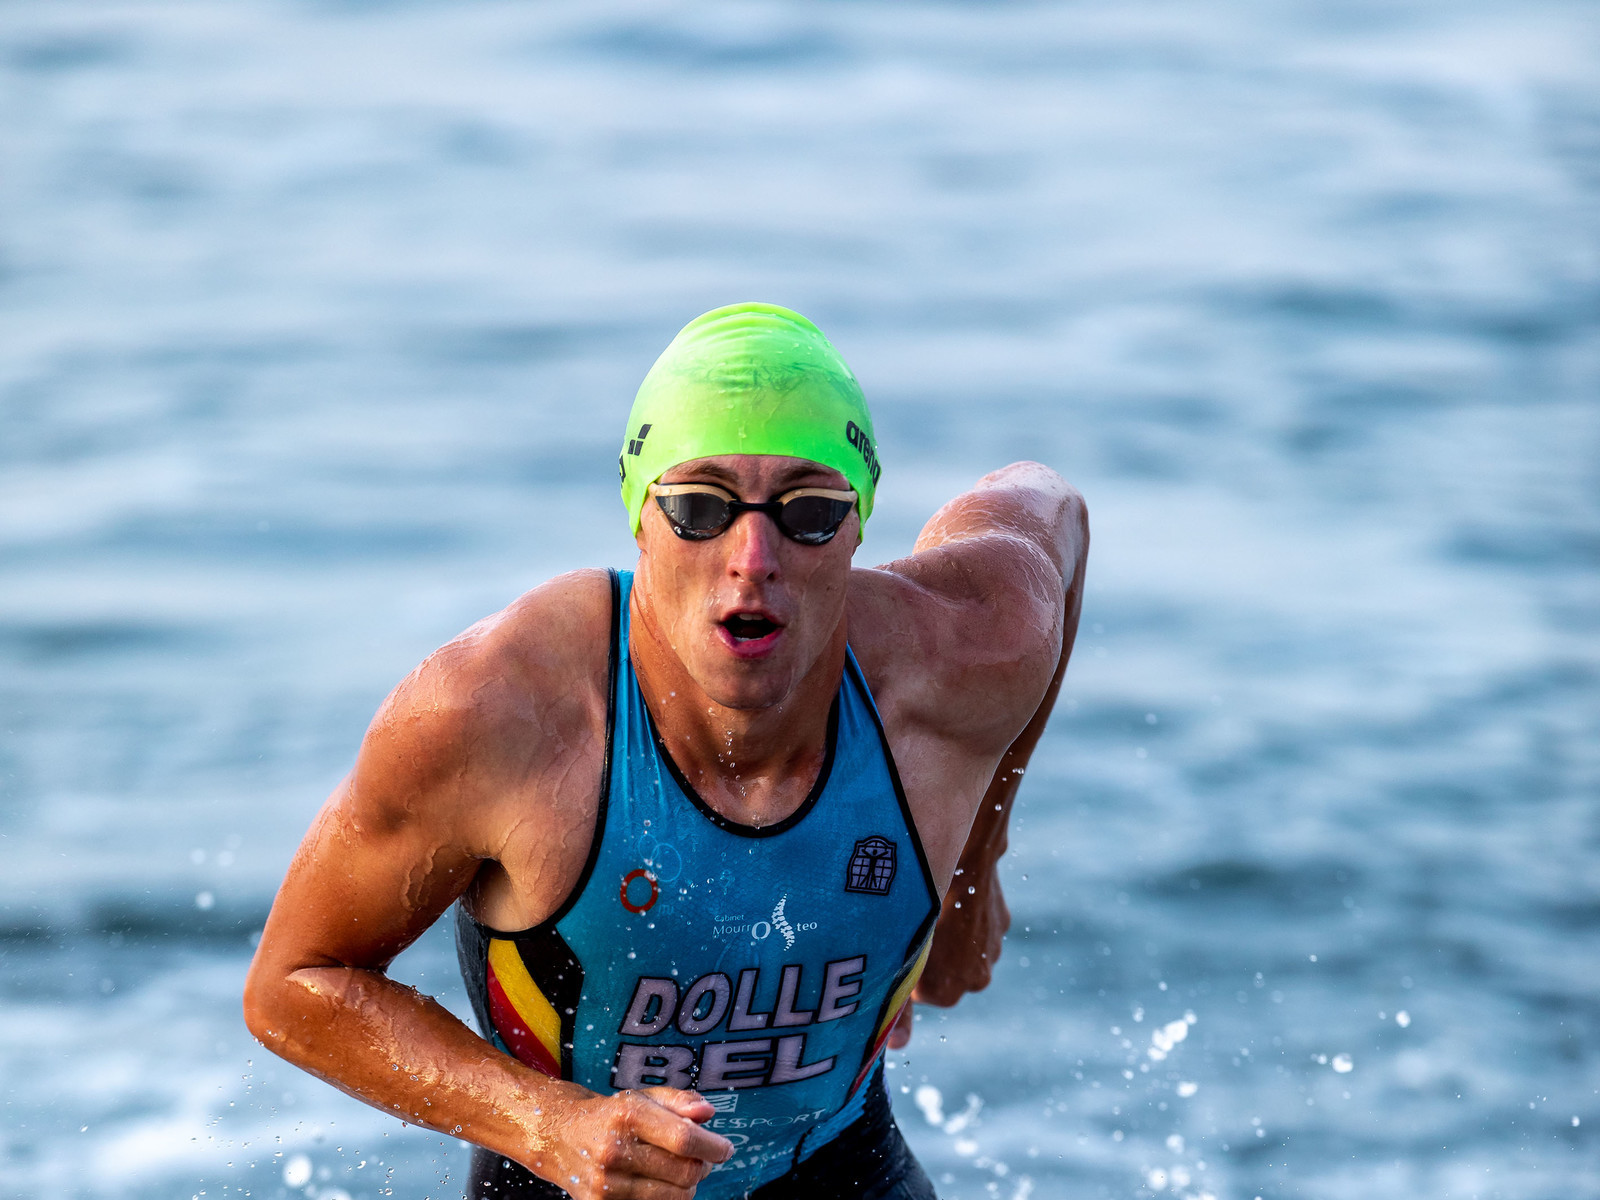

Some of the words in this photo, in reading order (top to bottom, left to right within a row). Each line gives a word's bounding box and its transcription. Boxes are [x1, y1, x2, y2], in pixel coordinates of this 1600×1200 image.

[846, 420, 880, 488] arena
[618, 955, 866, 1036] DOLLE
[610, 1033, 837, 1091] BEL
